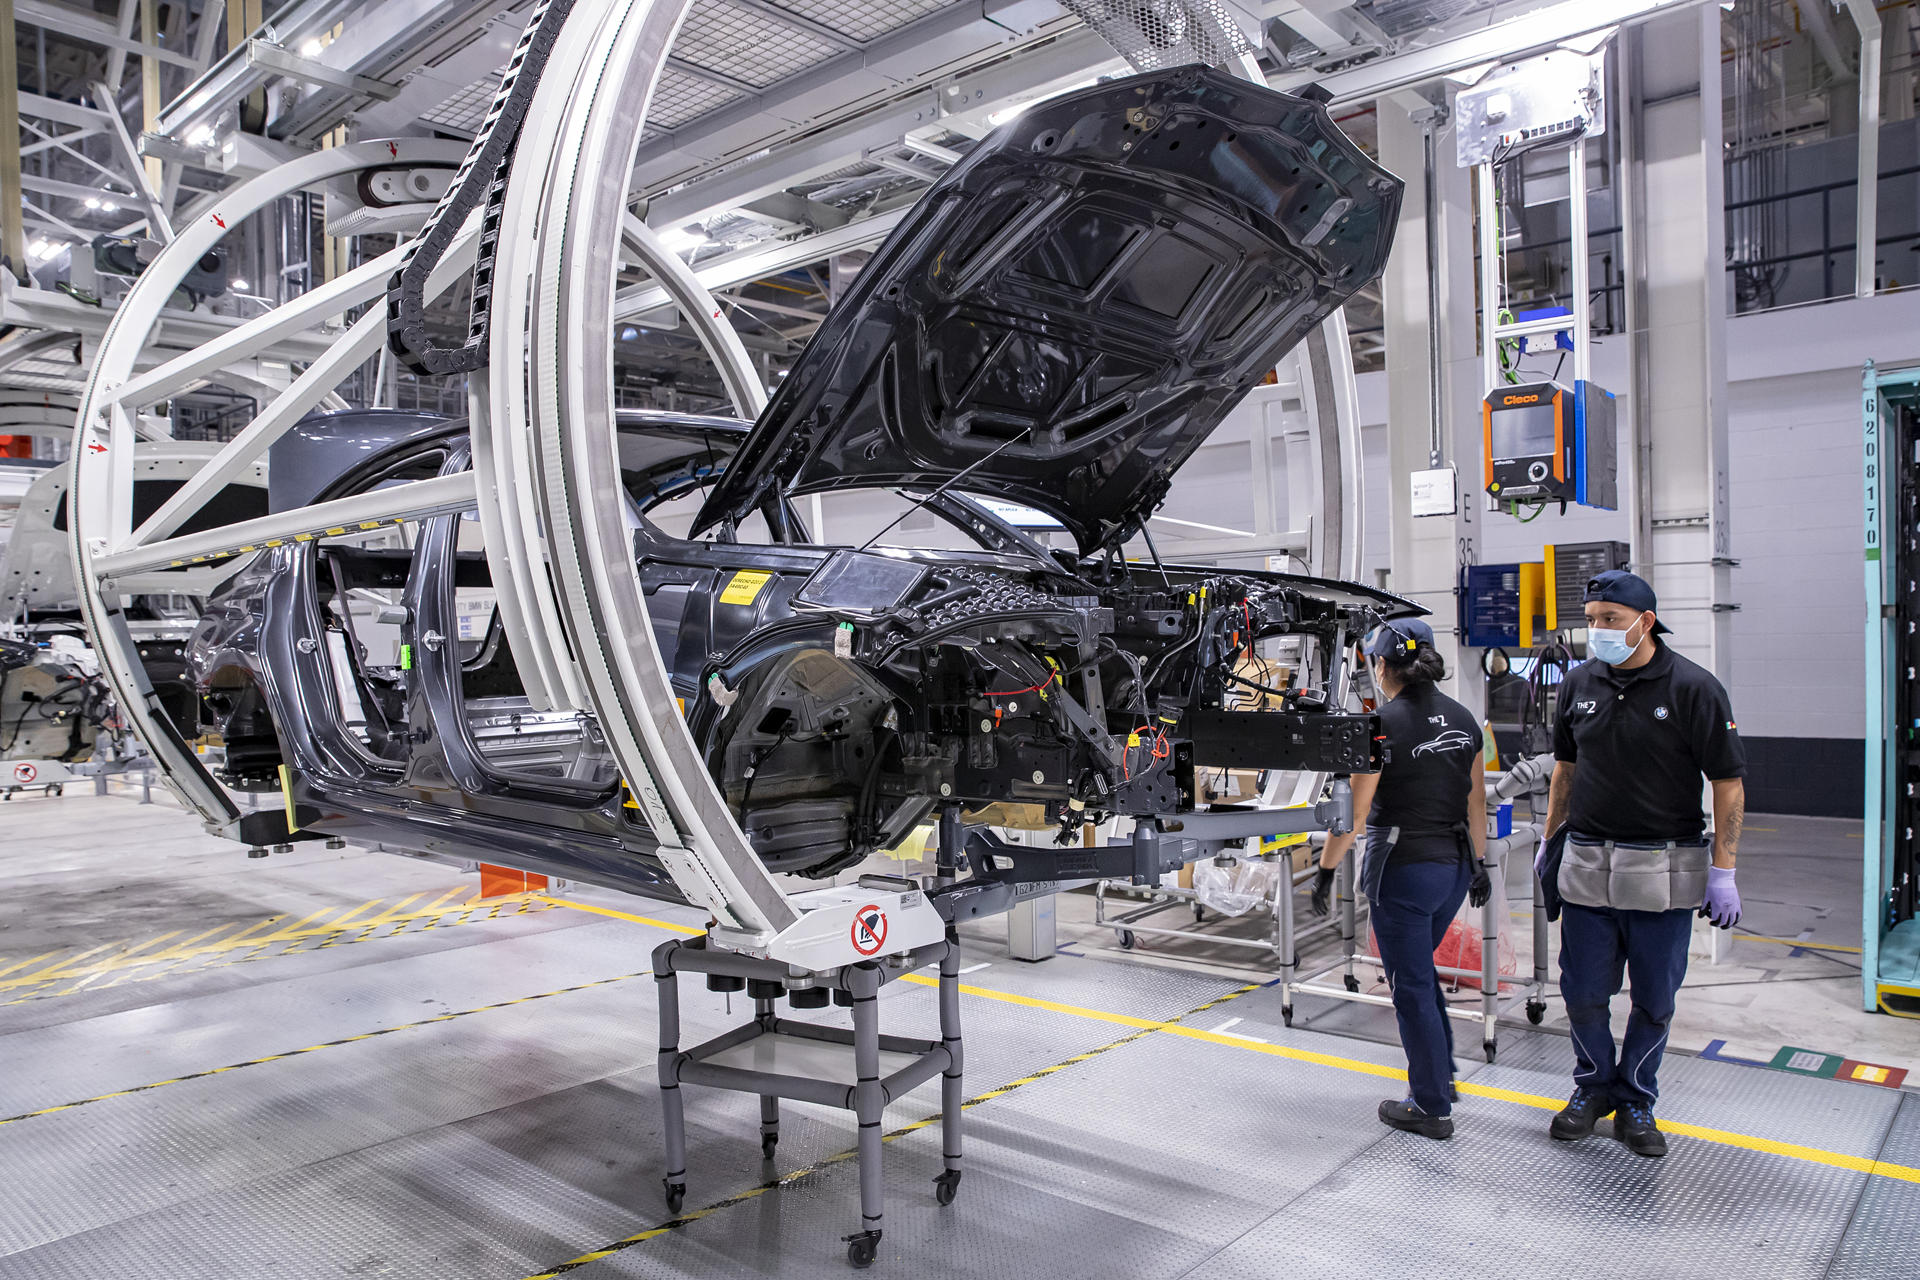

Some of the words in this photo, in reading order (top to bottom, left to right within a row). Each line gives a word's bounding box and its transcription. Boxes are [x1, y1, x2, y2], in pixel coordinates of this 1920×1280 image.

[1503, 394, 1539, 405] Cleco
[1865, 398, 1876, 544] 6208170
[1463, 493, 1471, 523] E
[1577, 701, 1589, 710] THE
[1587, 701, 1597, 714] 2
[1438, 714, 1448, 727] 2
